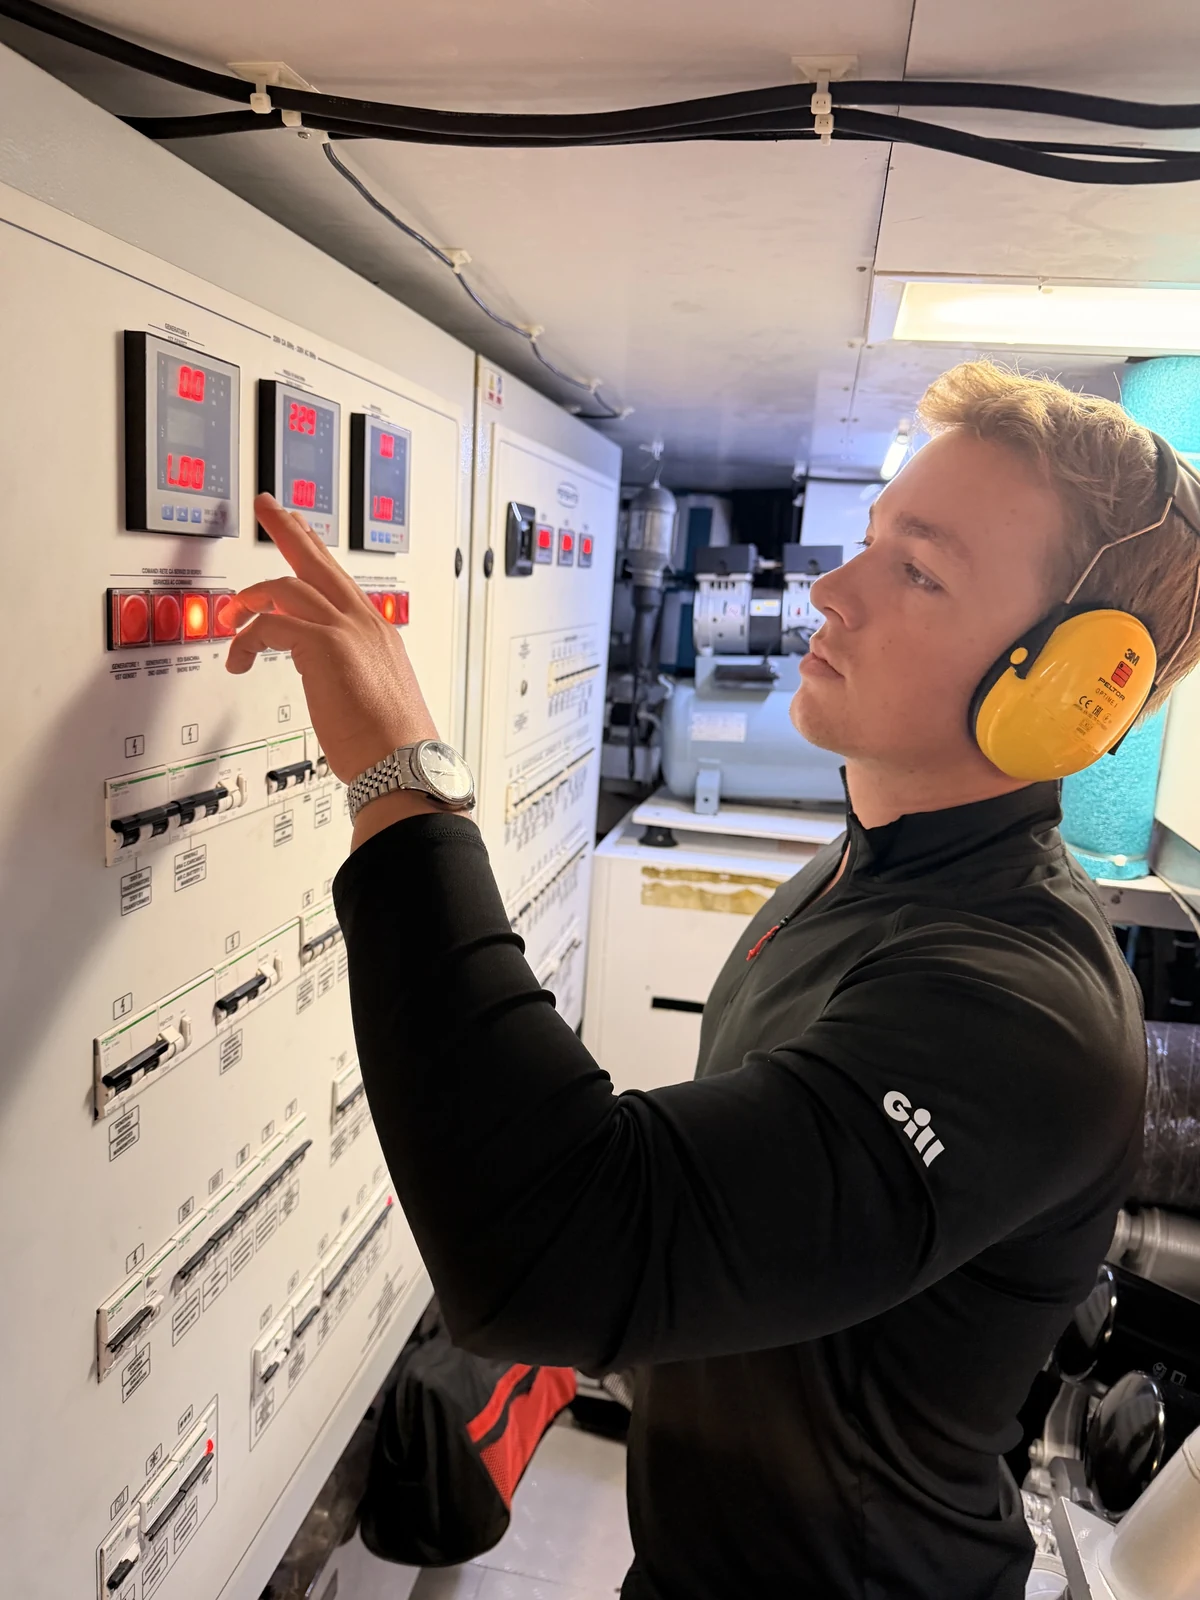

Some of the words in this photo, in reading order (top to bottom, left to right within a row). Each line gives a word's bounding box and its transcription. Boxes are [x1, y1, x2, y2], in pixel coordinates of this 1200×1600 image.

[290, 403, 317, 436] 229
[1124, 648, 1140, 666] 3M
[1098, 676, 1125, 701] PELTOR
[883, 1090, 945, 1168] Gill
